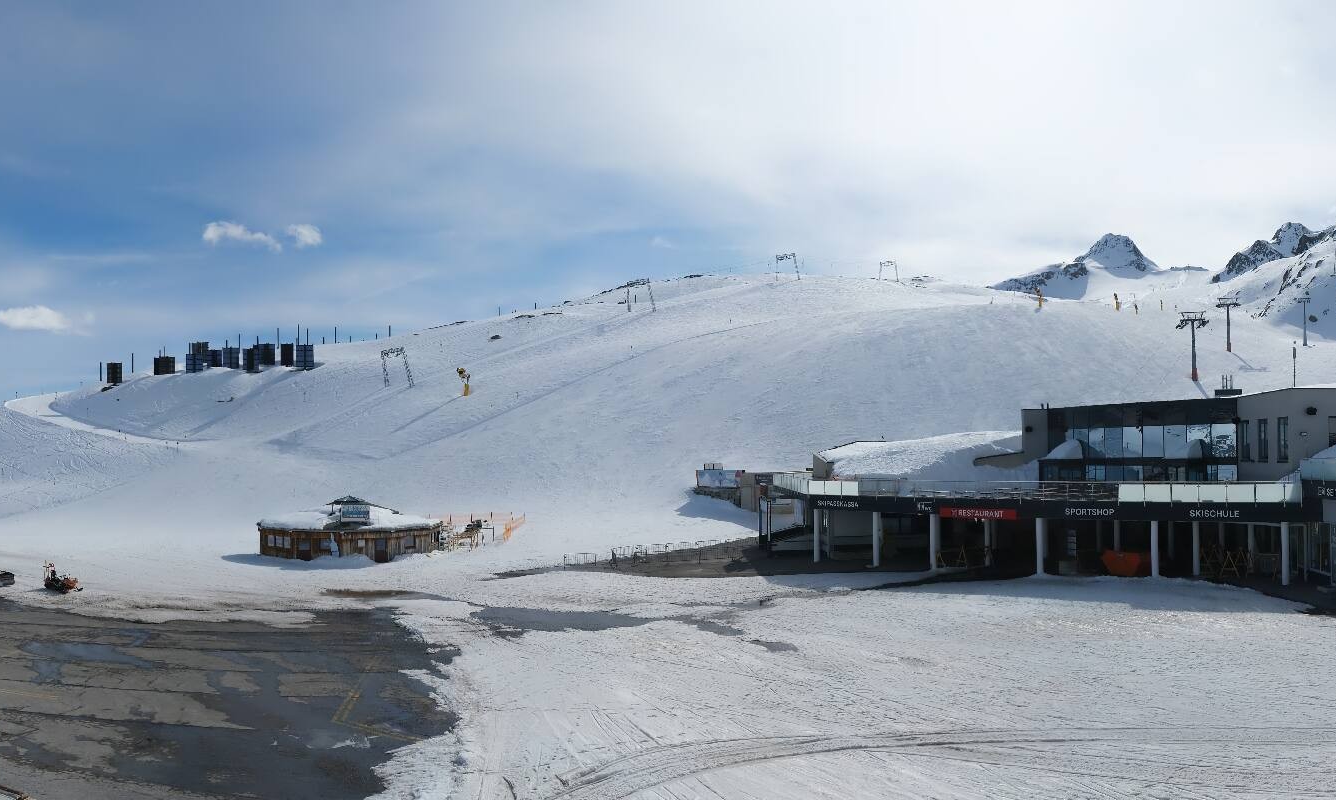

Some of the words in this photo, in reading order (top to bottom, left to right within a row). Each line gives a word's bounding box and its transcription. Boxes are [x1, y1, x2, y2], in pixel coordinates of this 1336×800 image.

[817, 500, 859, 508] SKIPASSKASSA
[958, 509, 1004, 518] RESTAURANT
[1065, 508, 1115, 516] SPORTSHOP
[1189, 509, 1240, 518] SKISCHULE
